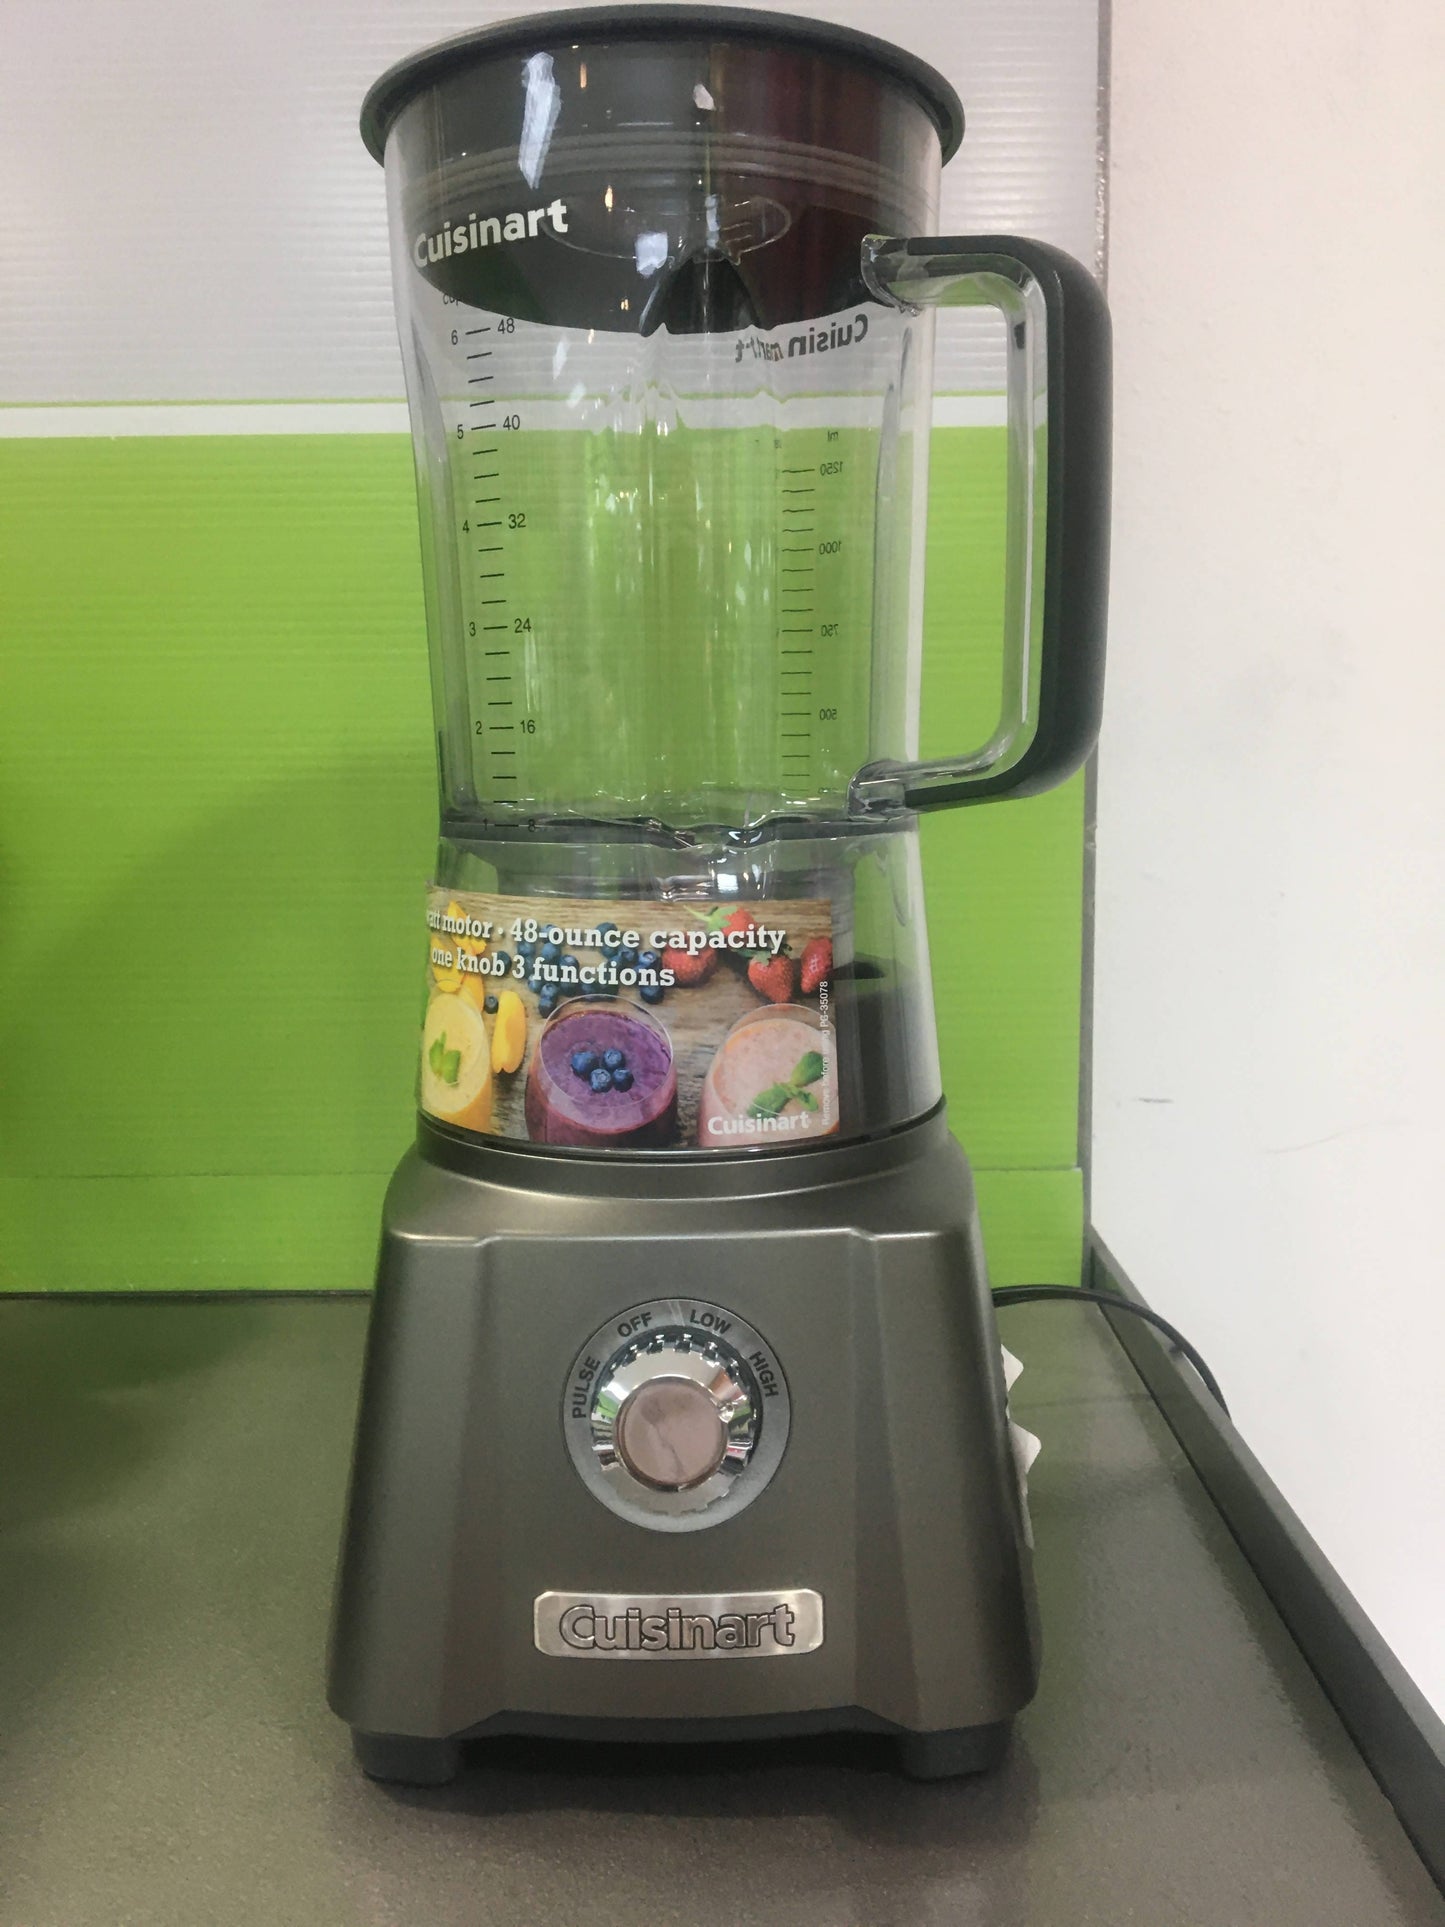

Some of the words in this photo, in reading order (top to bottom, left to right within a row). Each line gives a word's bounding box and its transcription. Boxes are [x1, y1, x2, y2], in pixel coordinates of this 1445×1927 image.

[414, 199, 569, 268] Cuisinart
[451, 329, 459, 346] 6
[497, 317, 515, 334] 48
[457, 424, 464, 440] 5
[502, 414, 521, 431] 40
[462, 519, 470, 534] 4
[508, 512, 527, 529] 32
[469, 621, 477, 637] 3
[514, 617, 532, 633] 24
[475, 720, 483, 735] 2
[520, 719, 536, 734] 16
[442, 914, 493, 939] motor
[510, 917, 640, 948] 48-ounce
[650, 923, 786, 955] capacity
[432, 946, 453, 967] one
[456, 946, 506, 977] knob
[511, 954, 526, 979] 3
[532, 956, 676, 987] functions
[707, 1110, 811, 1136] Cuisinart
[616, 1311, 653, 1338] OFF
[689, 1309, 731, 1336] LOW
[572, 1356, 601, 1419] PULSE
[748, 1351, 779, 1399] HIGH
[559, 1603, 796, 1651] Cuisinart
